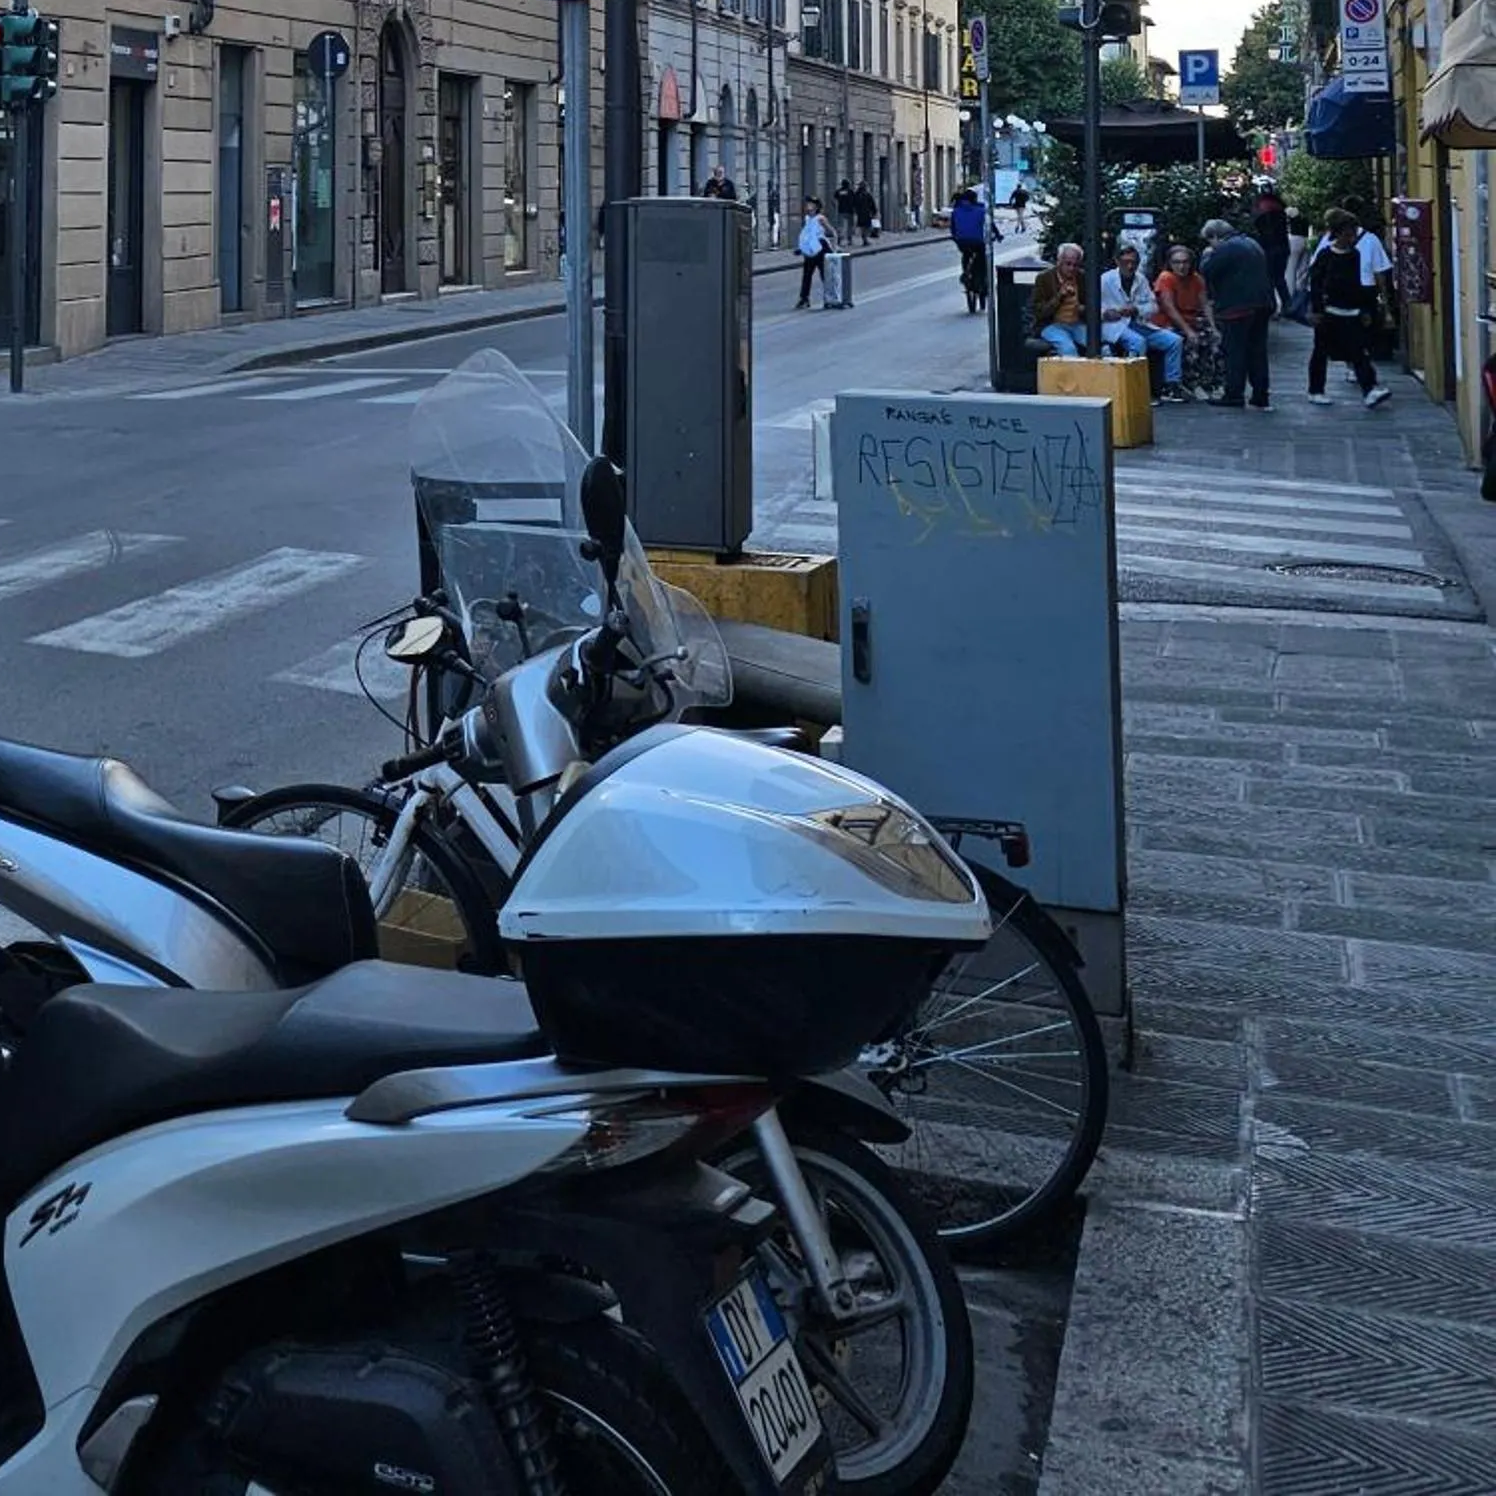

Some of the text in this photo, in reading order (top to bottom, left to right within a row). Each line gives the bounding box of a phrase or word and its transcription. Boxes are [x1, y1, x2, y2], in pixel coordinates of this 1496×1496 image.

[1186, 55, 1209, 82] P
[1348, 55, 1379, 66] 0-24
[969, 416, 1029, 434] PLACE
[718, 1288, 762, 1365] DY
[750, 1358, 817, 1465] 20401
